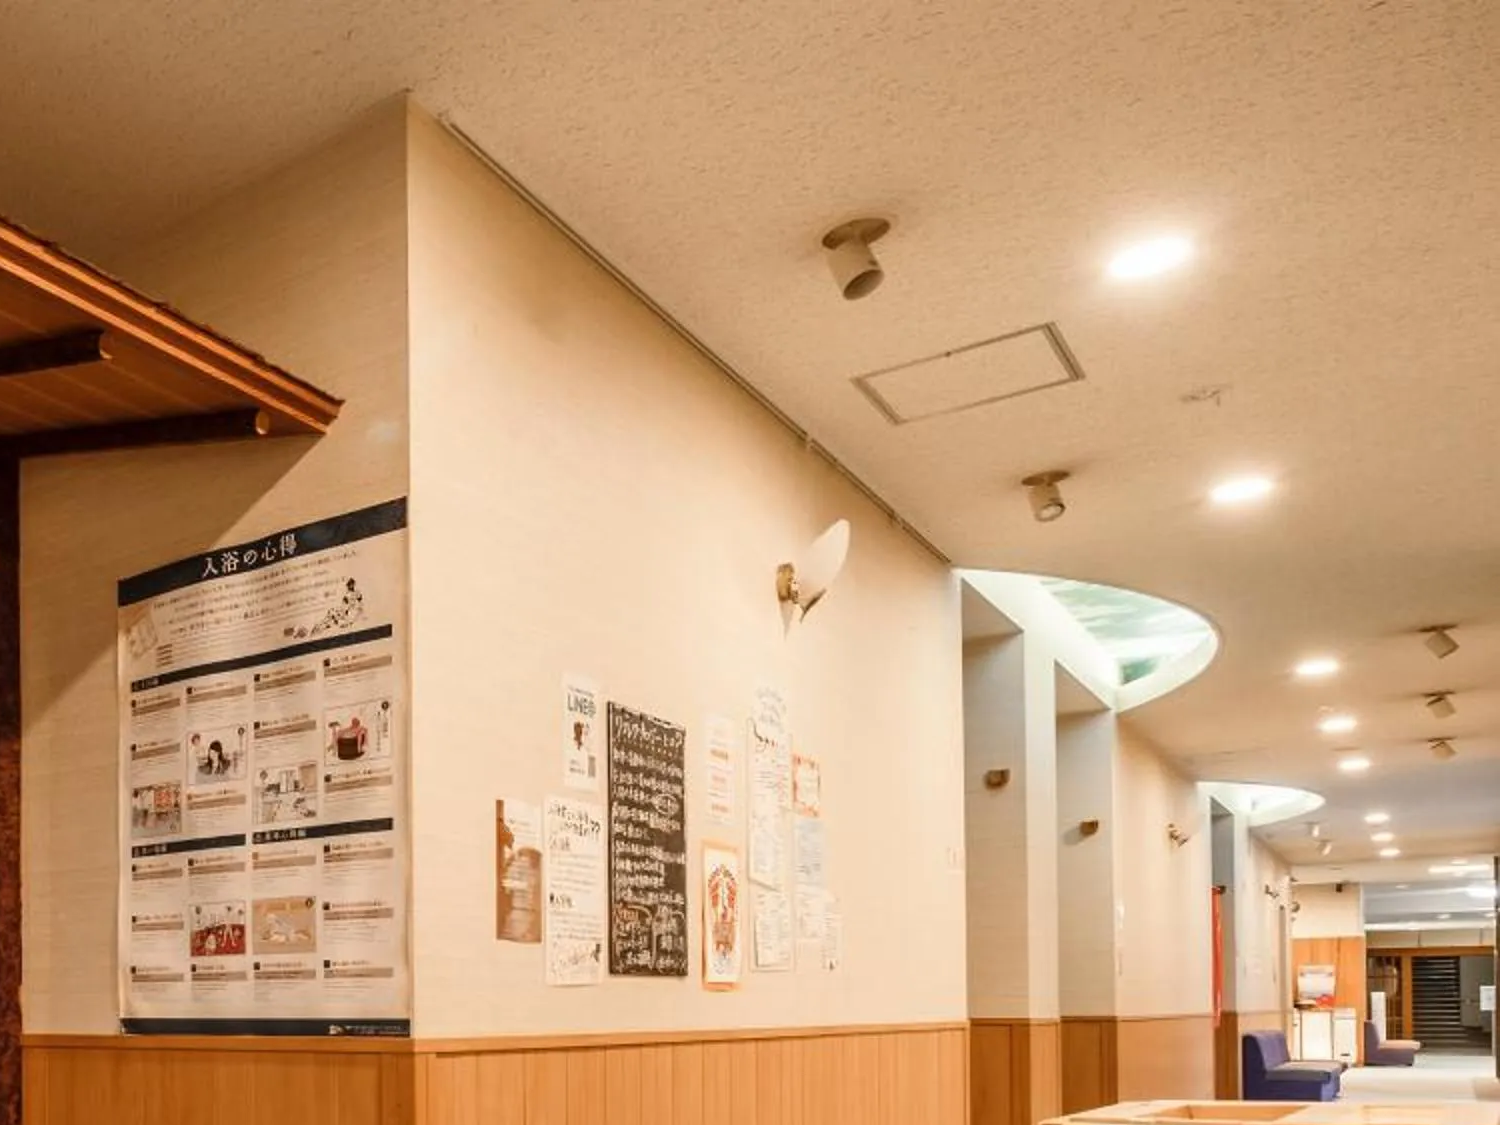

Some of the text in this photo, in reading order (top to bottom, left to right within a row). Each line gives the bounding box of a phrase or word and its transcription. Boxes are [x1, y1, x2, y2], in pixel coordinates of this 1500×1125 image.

[202, 533, 297, 578] 入浴の心得
